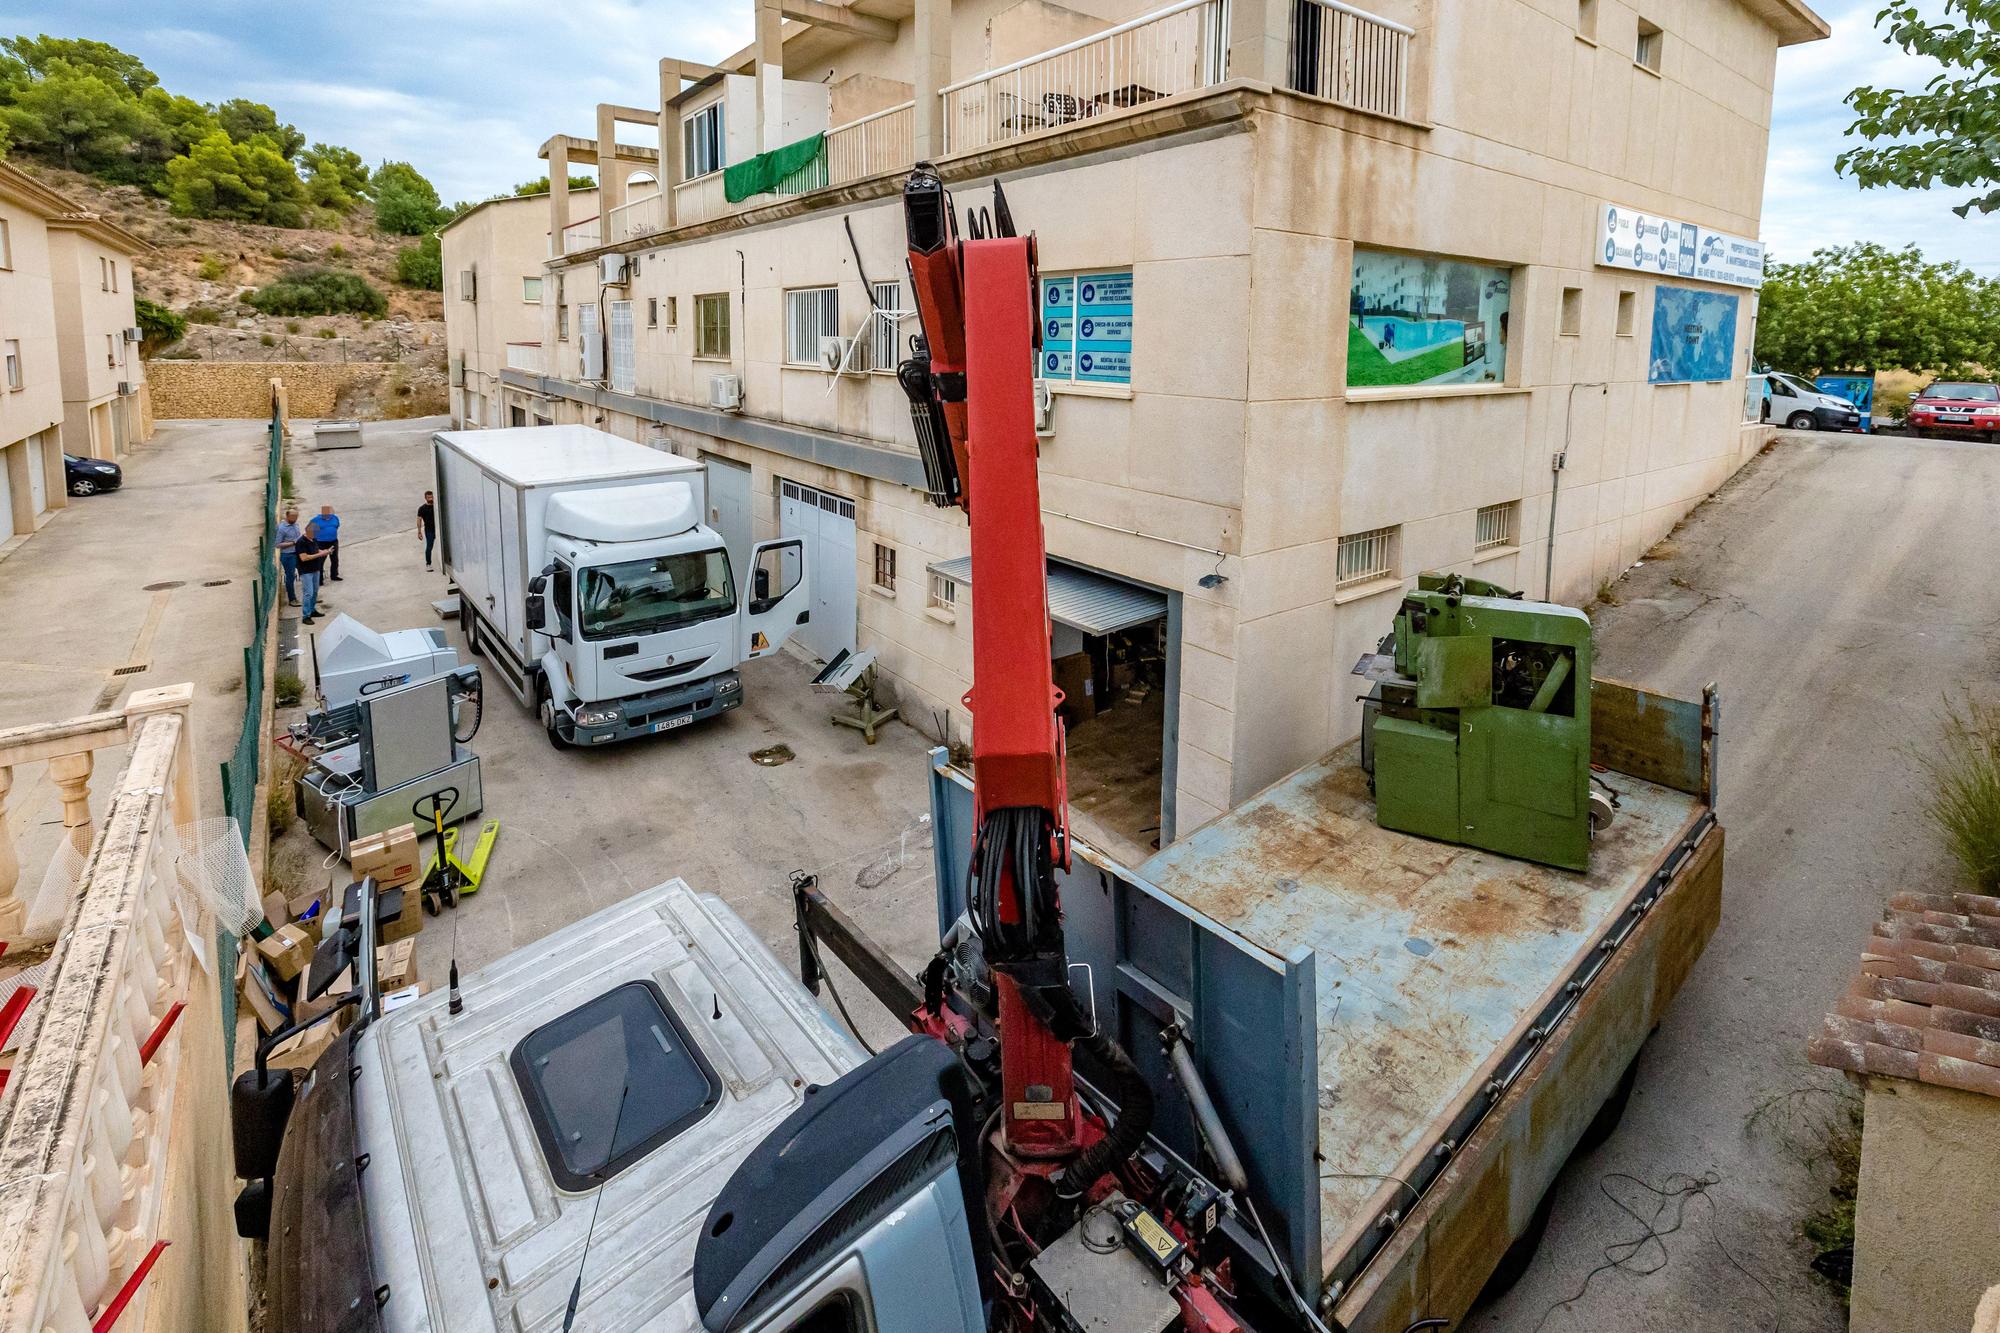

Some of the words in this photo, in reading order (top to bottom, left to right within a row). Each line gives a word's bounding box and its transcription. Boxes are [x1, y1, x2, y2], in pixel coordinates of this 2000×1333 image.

[1682, 227, 1696, 248] POOL
[1680, 253, 1695, 274] SHOP
[1685, 336, 1699, 344] POINT
